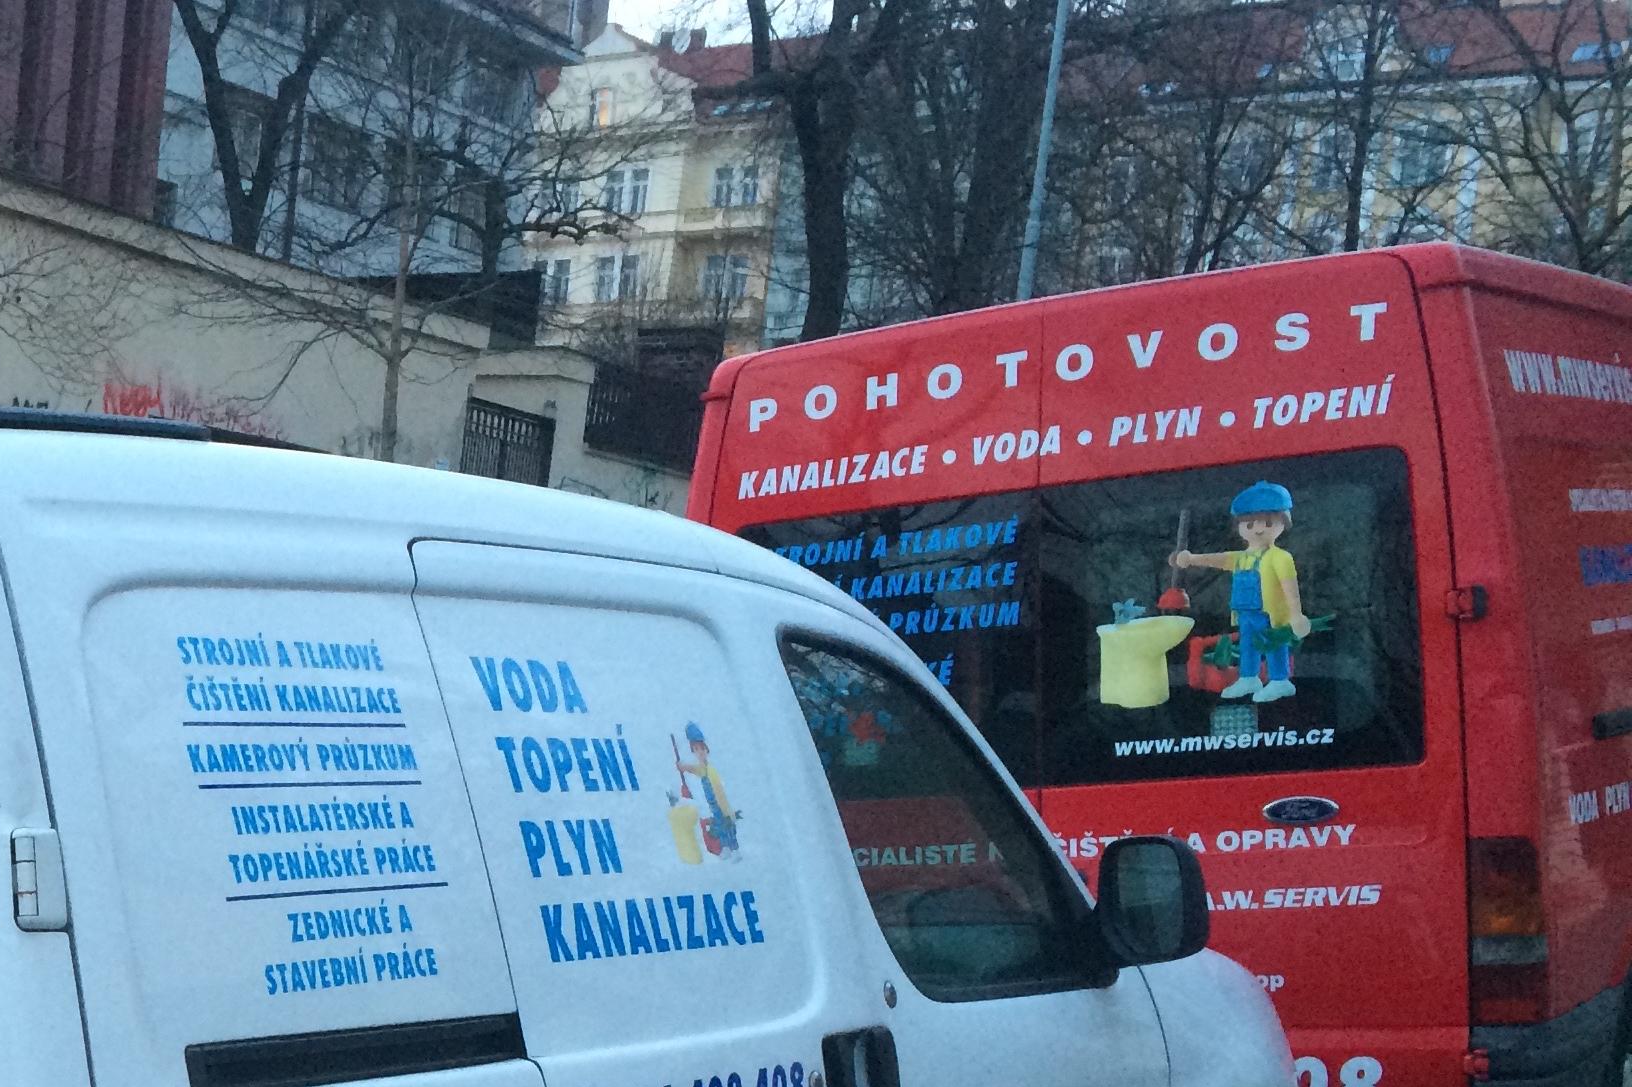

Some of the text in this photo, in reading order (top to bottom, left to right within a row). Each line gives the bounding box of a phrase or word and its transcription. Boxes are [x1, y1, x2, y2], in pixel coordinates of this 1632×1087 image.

[749, 303, 1388, 432] POHOTOVOST
[738, 374, 1395, 500] KANALIZACE VODA PLYN TOPENÍ
[871, 536, 888, 559] A
[899, 514, 1018, 555] TLAKOVÉ
[851, 562, 1018, 600] KANALIZACE
[890, 600, 1021, 635] PRŮZKUM
[176, 632, 384, 671] STROJNÍ A TLAKOVÉ
[185, 675, 402, 714] ČIŠTĚNÍ KANALIZACE
[469, 656, 588, 714] VODA
[186, 736, 418, 773] KAMEROVÝ PRŮZKUM
[495, 723, 640, 793] TOPENÍ
[1114, 726, 1335, 757] www.mwservis.cz
[231, 795, 414, 836] INSTALATÉRSKÉ A
[228, 838, 437, 884] TOPENÁŘSKÉ PRÁCE
[519, 818, 623, 878] PLYN
[1186, 832, 1206, 854] A
[1216, 823, 1357, 852] OPRAVY
[286, 898, 414, 943] ZEDNICKÉ A
[539, 890, 765, 964] KANALIZACE
[264, 942, 439, 996] STAVEBNÍ PRÁCE
